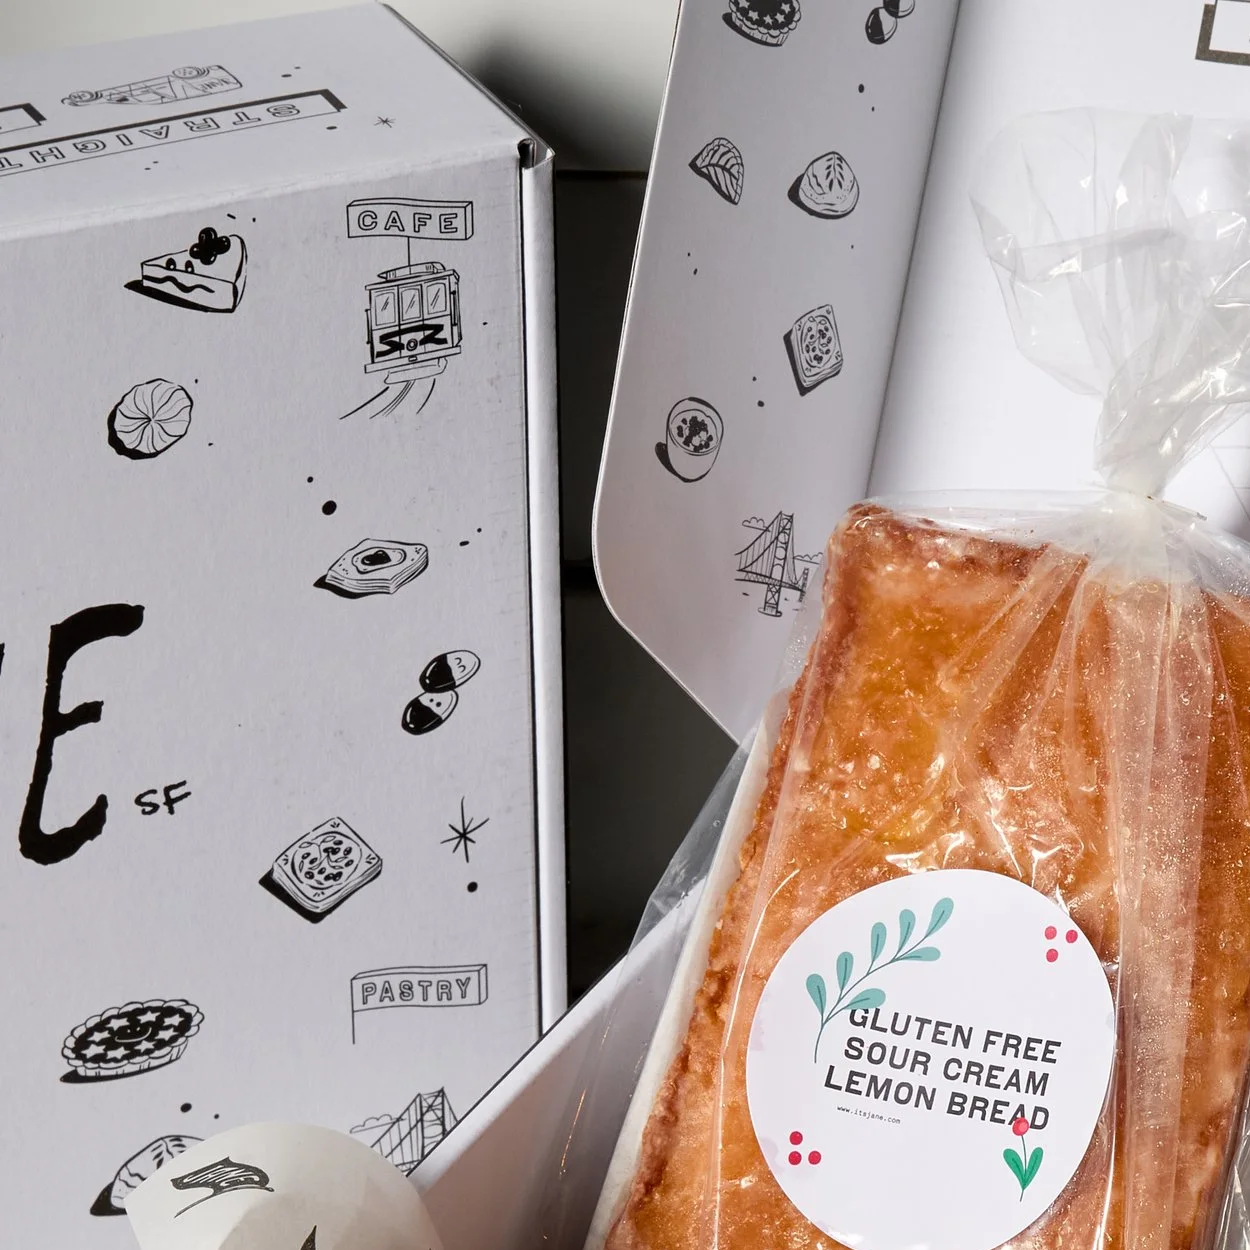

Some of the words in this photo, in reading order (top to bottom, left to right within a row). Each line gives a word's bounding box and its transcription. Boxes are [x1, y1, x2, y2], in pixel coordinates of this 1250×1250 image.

[356, 210, 459, 234] CAFE
[134, 780, 192, 816] SF
[361, 975, 472, 1005] PASTRY
[848, 1006, 974, 1050] GLUTEN
[981, 1029, 1063, 1065] FREE
[843, 1036, 932, 1076] SOUR
[942, 1056, 1050, 1097] CREAM
[823, 1064, 937, 1111] LEMON
[946, 1092, 1051, 1131] BREAD
[836, 1104, 902, 1125] www.itsjane.com
